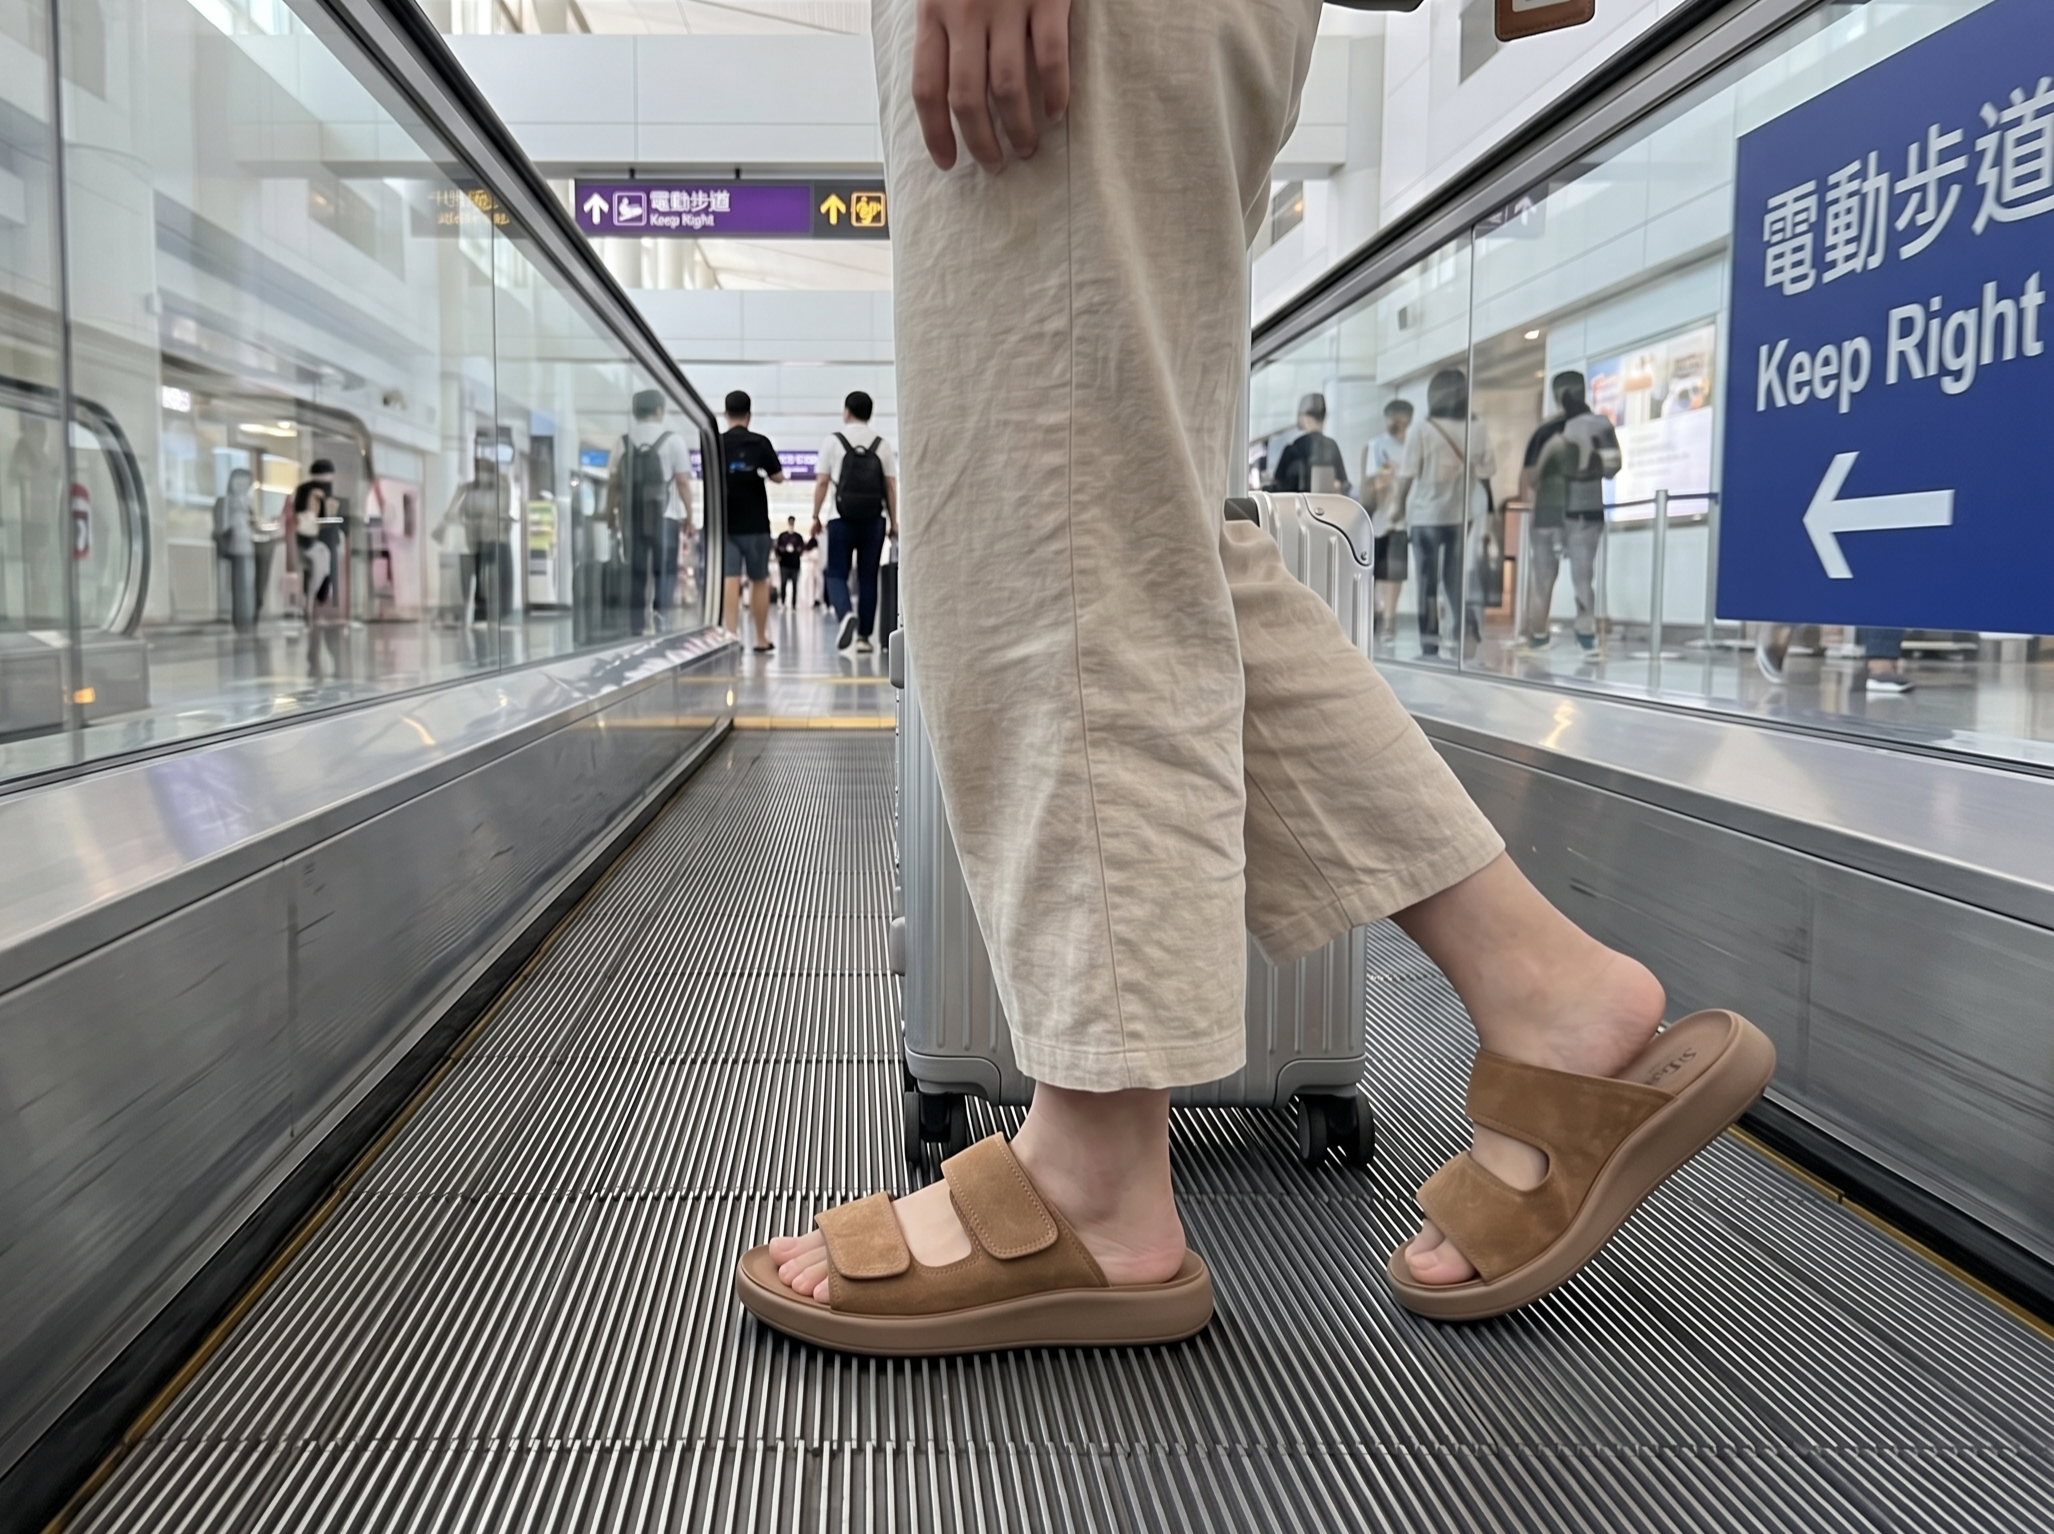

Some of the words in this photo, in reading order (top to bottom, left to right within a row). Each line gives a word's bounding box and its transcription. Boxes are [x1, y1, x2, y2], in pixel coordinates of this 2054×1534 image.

[649, 189, 731, 212] 電動步道
[650, 213, 679, 229] Keep
[1763, 76, 2054, 296] 電動步道
[1756, 335, 1871, 414] Keep
[1886, 271, 2046, 396] Right
